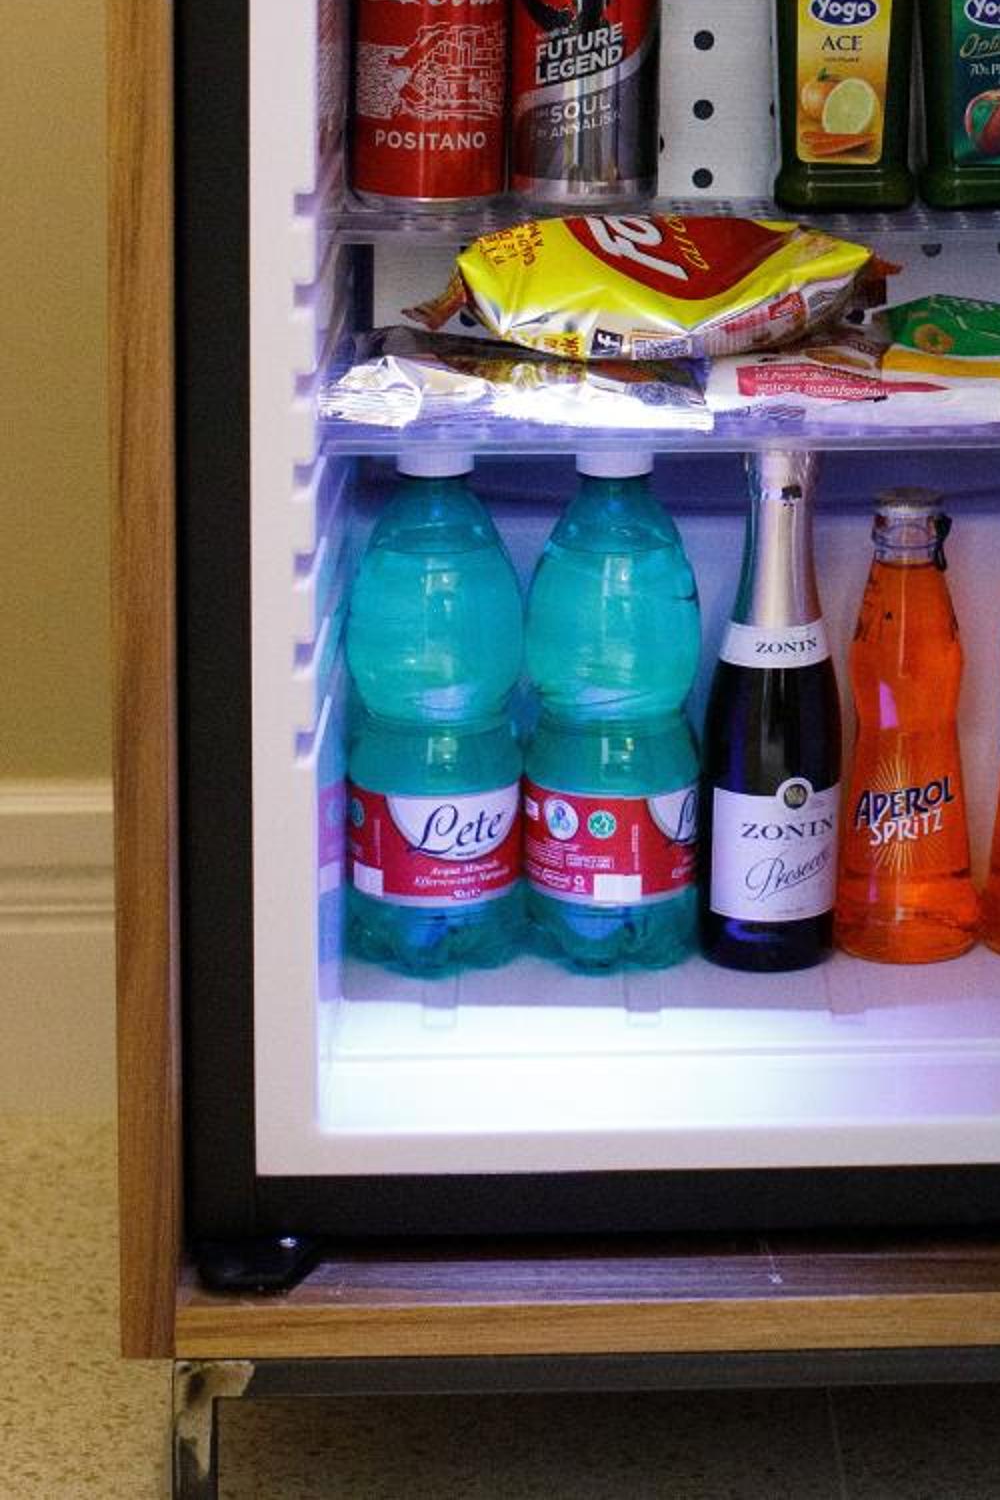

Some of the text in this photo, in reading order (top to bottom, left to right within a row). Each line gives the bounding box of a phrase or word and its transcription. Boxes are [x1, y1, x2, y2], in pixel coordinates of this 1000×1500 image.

[536, 22, 623, 62] FUTURE
[821, 35, 863, 51] ACE
[535, 44, 623, 85] LEGEND
[375, 129, 486, 151] POSITANO
[755, 637, 817, 653] ZONIN
[854, 775, 955, 831] APEROL
[416, 804, 508, 854] Lete
[741, 815, 833, 841] ZONIN
